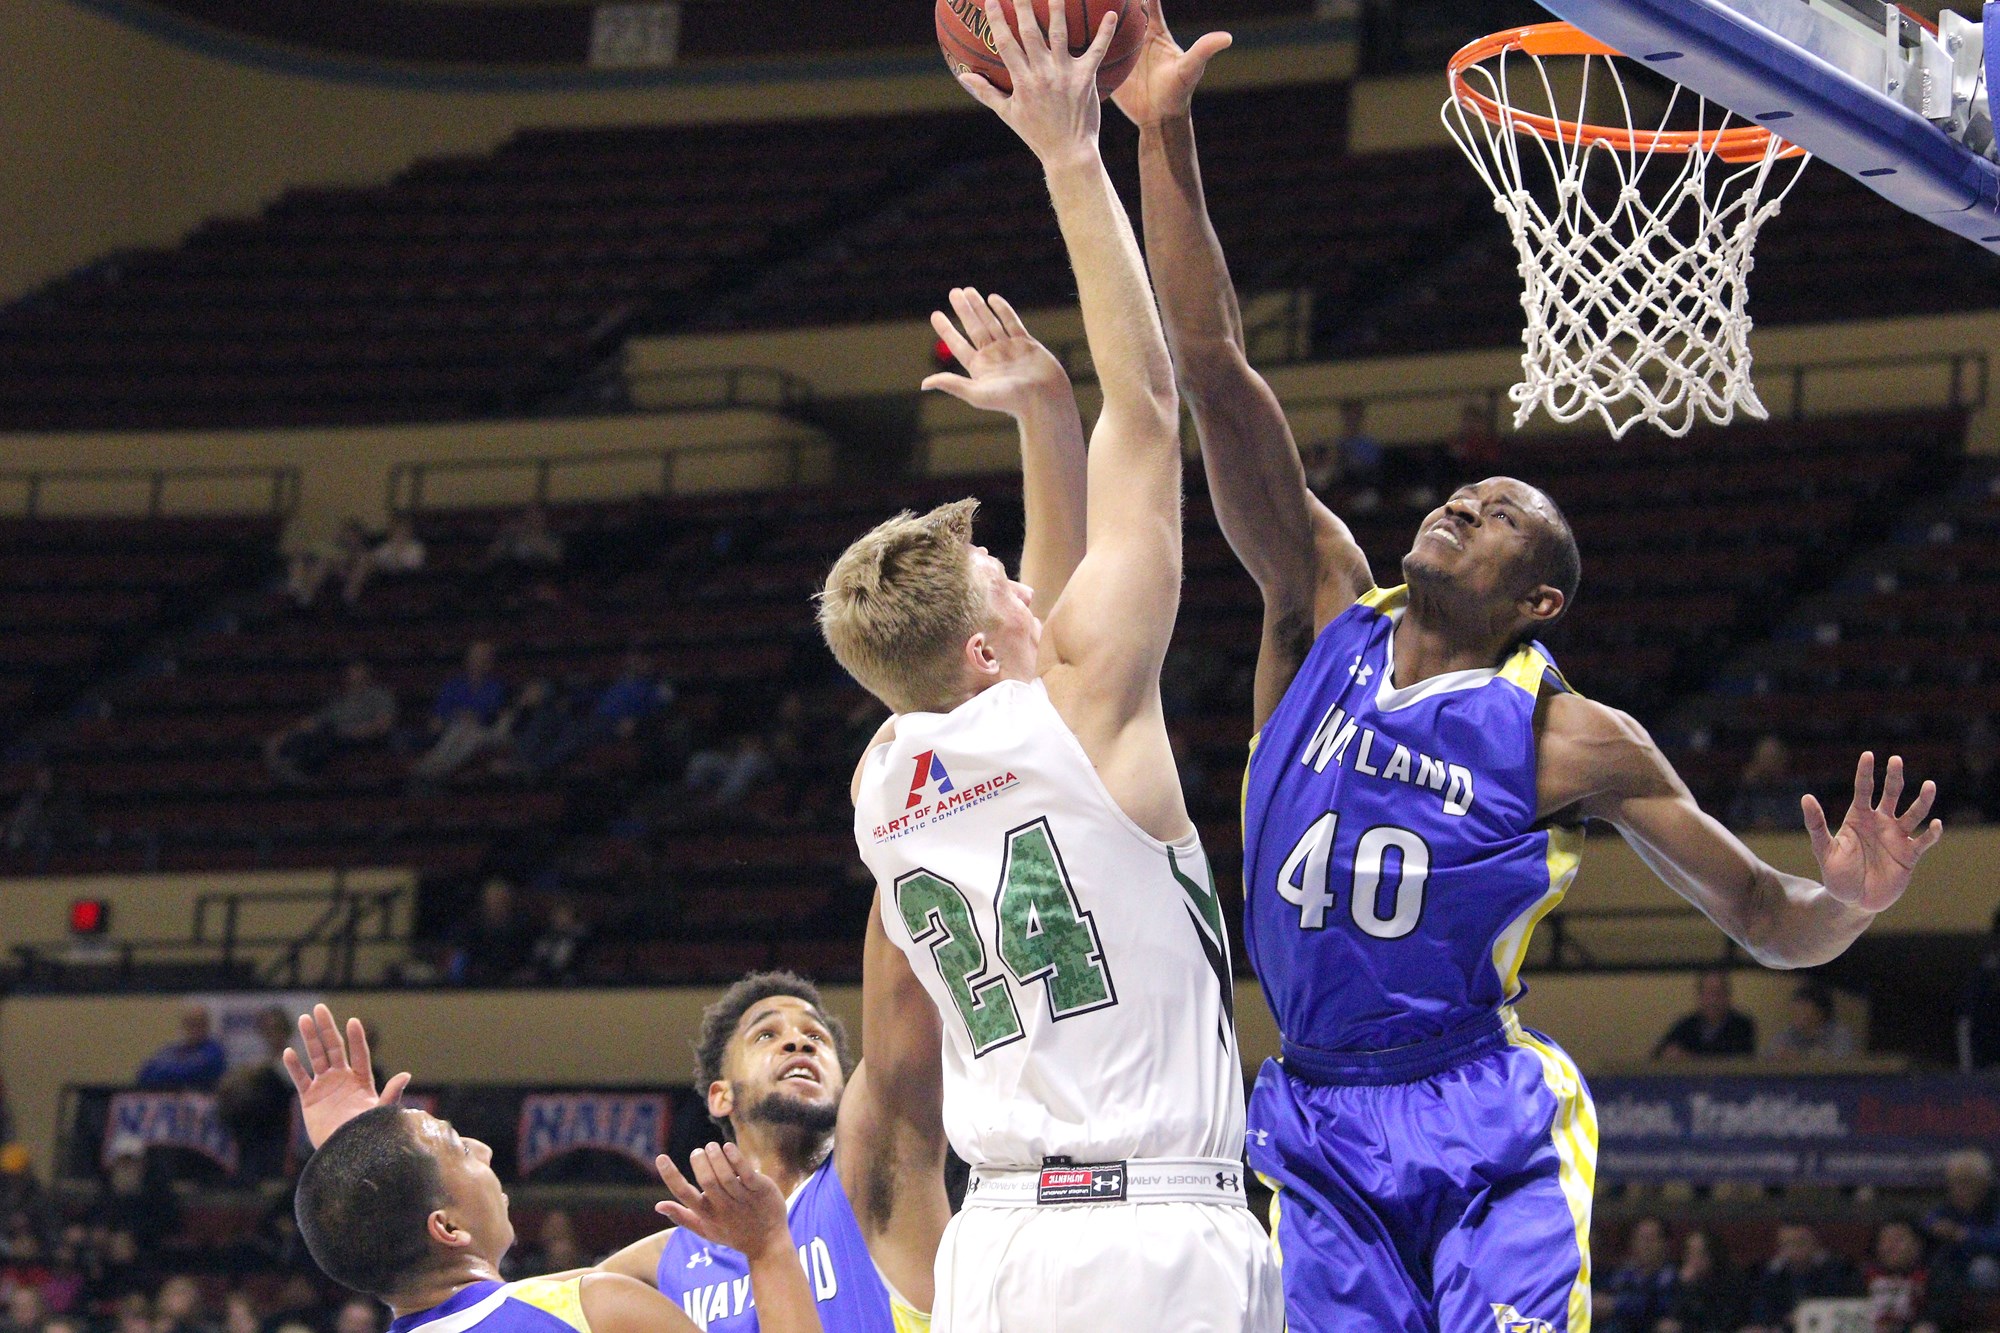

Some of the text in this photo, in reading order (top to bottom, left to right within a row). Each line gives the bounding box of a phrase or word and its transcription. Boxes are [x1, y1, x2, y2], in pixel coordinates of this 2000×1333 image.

[872, 771, 1018, 840] HEART OF AMERICA
[931, 790, 999, 824] CONFERENCE
[1276, 809, 1432, 940] 40
[894, 815, 1119, 1060] 24
[522, 1097, 665, 1162] NAIA
[1048, 1173, 1085, 1184] AUTHENTIC
[1127, 1175, 1211, 1185] UNDER ARM
